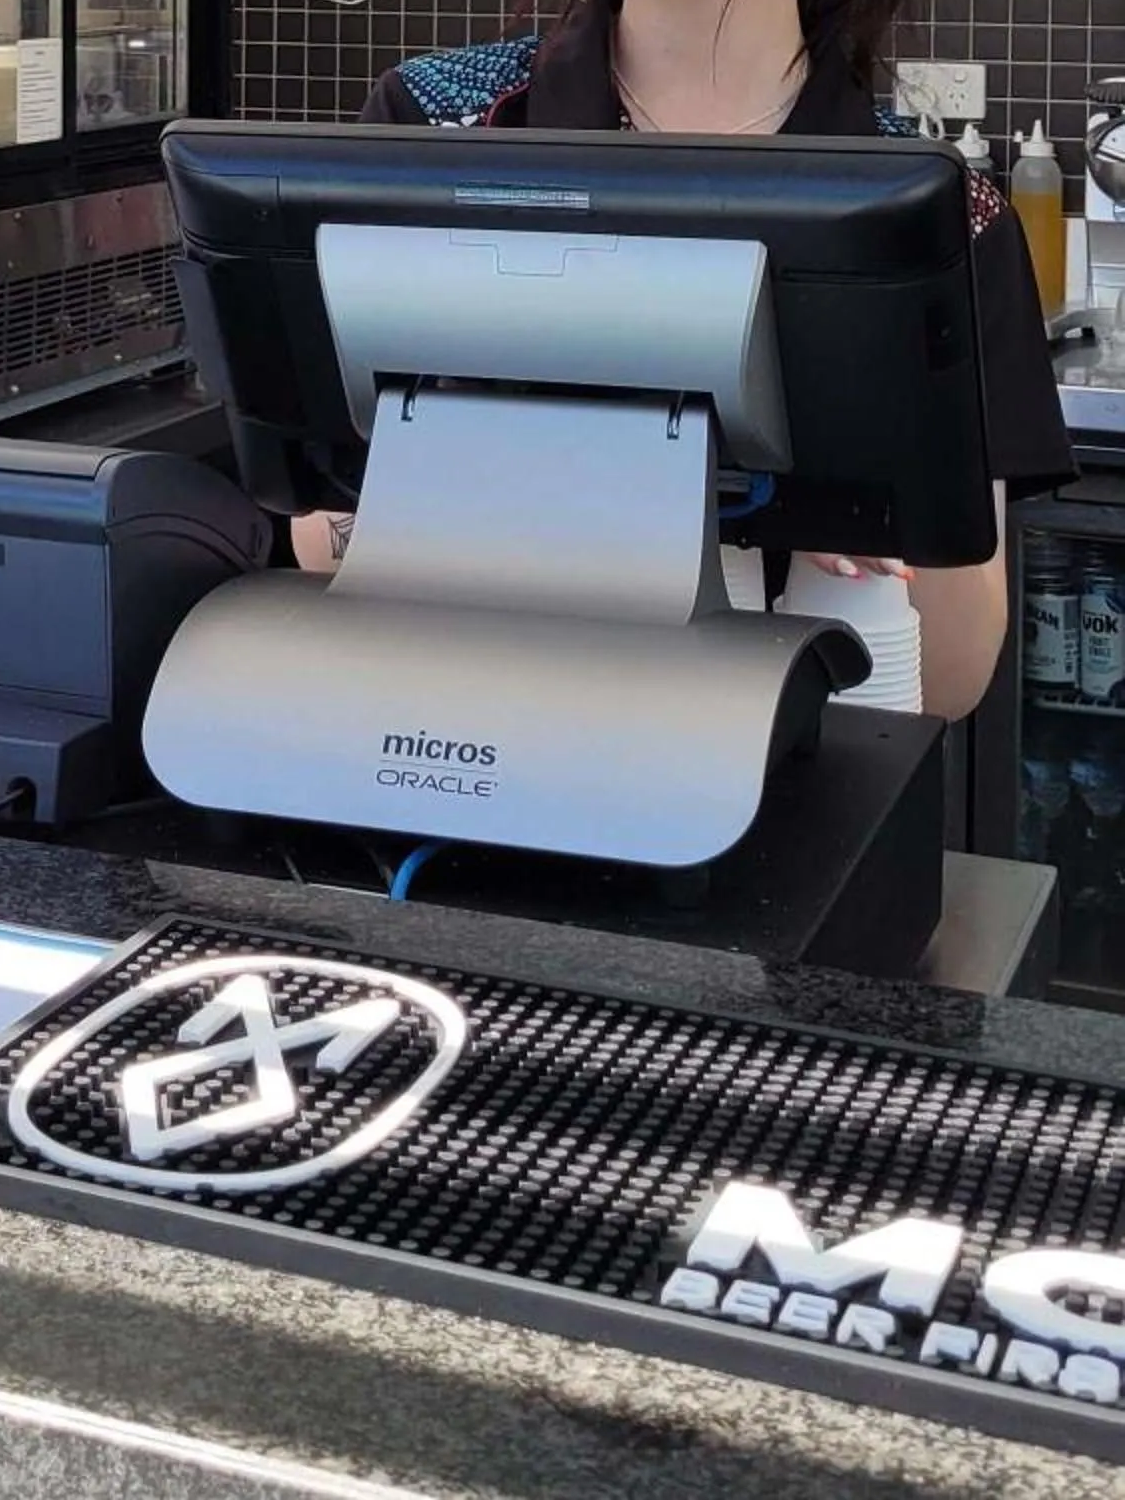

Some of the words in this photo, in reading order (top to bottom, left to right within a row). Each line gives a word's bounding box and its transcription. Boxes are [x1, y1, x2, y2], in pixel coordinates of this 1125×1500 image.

[382, 730, 497, 765] micros
[376, 769, 493, 797] ORACLE
[661, 1267, 895, 1353] BEER
